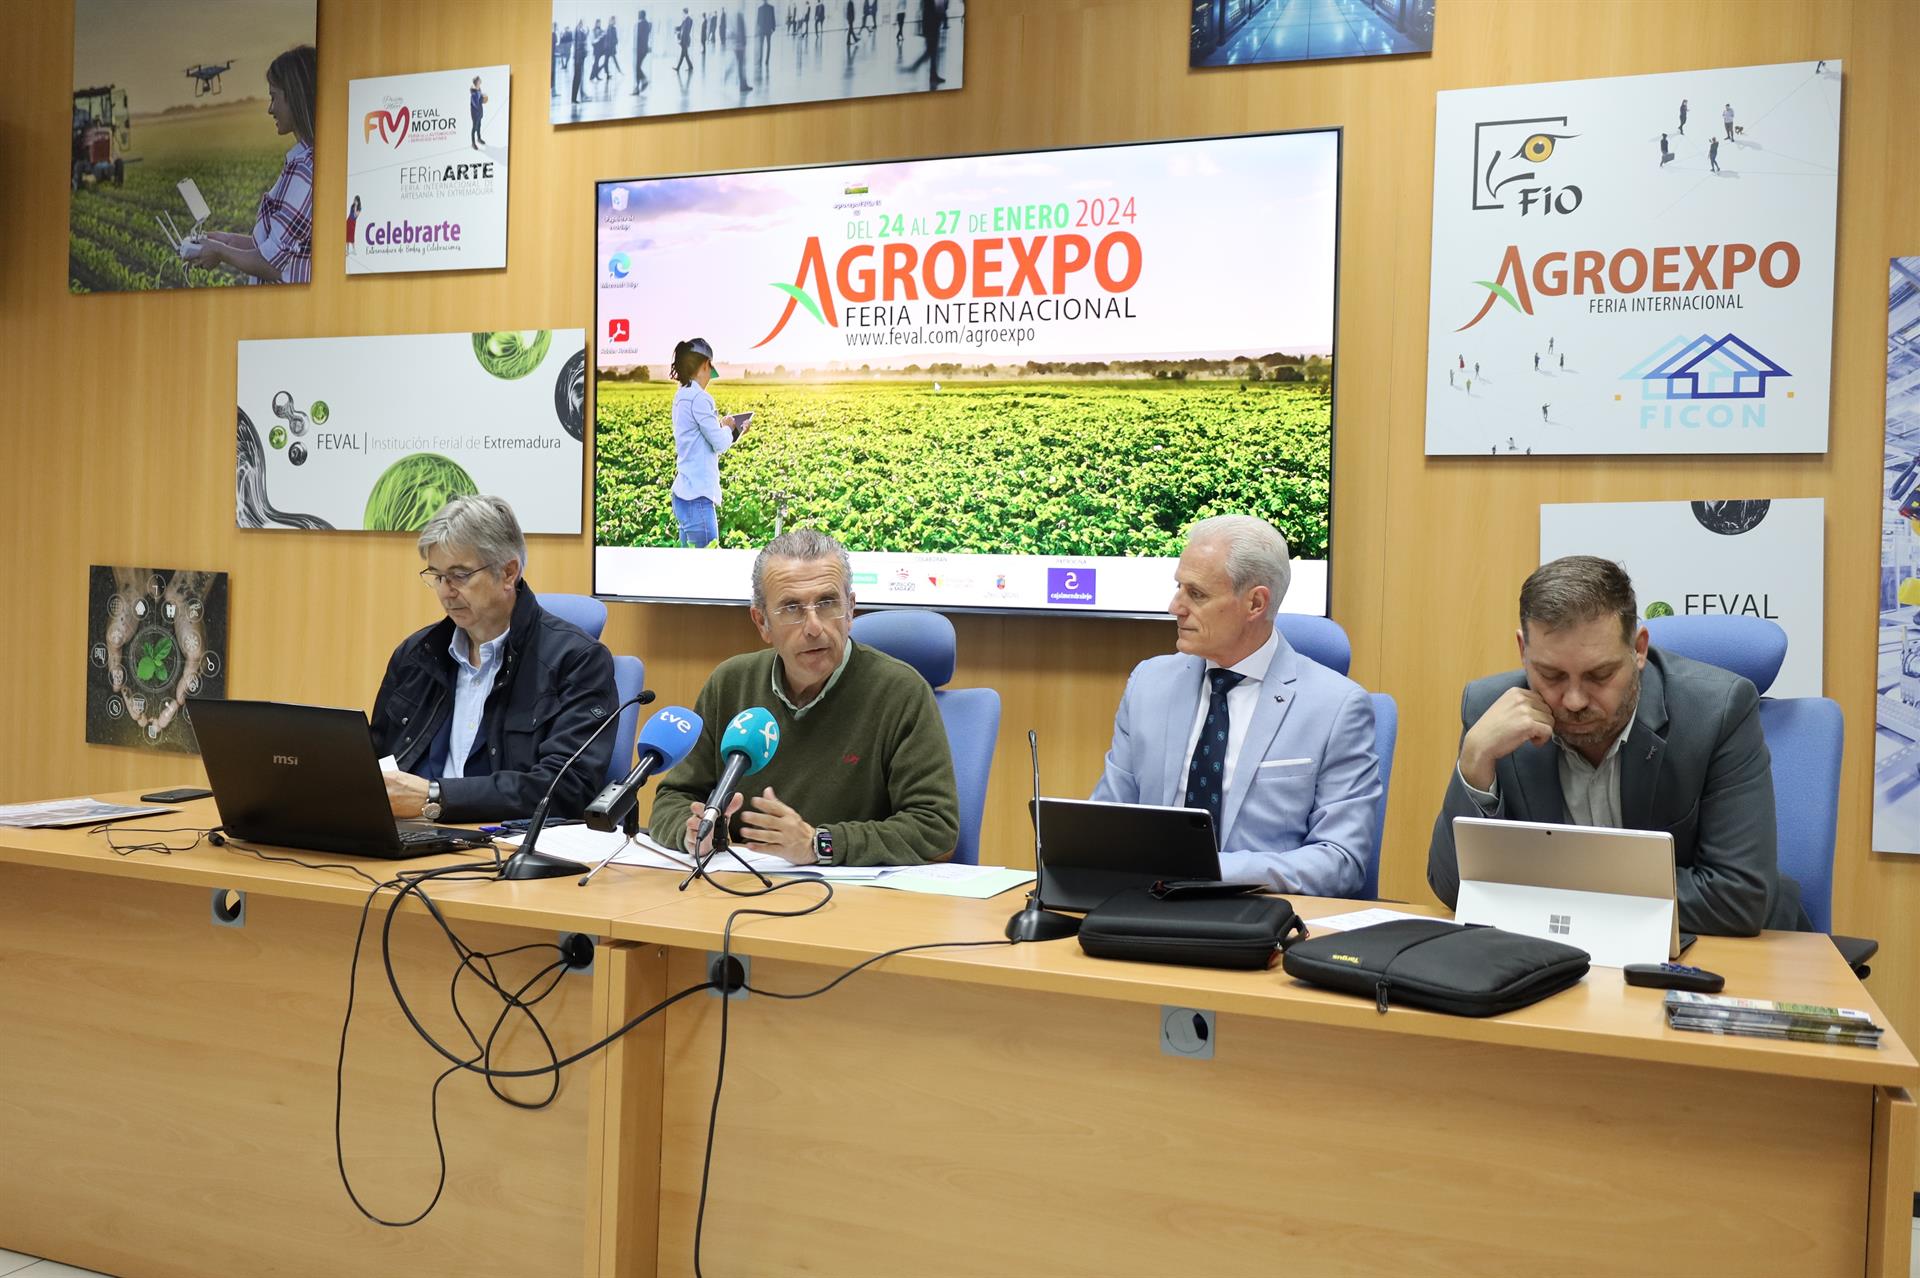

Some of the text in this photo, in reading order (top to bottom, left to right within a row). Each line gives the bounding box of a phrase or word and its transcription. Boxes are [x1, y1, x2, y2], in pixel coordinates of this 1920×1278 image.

[411, 108, 440, 119] FEVAL
[411, 118, 456, 132] MOTOR
[400, 162, 494, 184] FERinARTE
[847, 196, 1136, 239] DEL 24 AL 27 DE ENERO 2024
[365, 219, 461, 245] Celebrarte
[751, 230, 1143, 349] AGROEXPO
[1453, 241, 1800, 333] AGROEXPO
[846, 297, 1136, 327] FERIA INTERNACIONAL
[1589, 294, 1744, 313] FERIA INTERNACIONAL
[846, 326, 1035, 348] www.feval.com/agroexpo
[1640, 404, 1766, 430] FICON
[317, 433, 561, 450] FEVAL Institución Ferial de Extremadura
[660, 711, 692, 733] tve
[273, 755, 298, 765] msi
